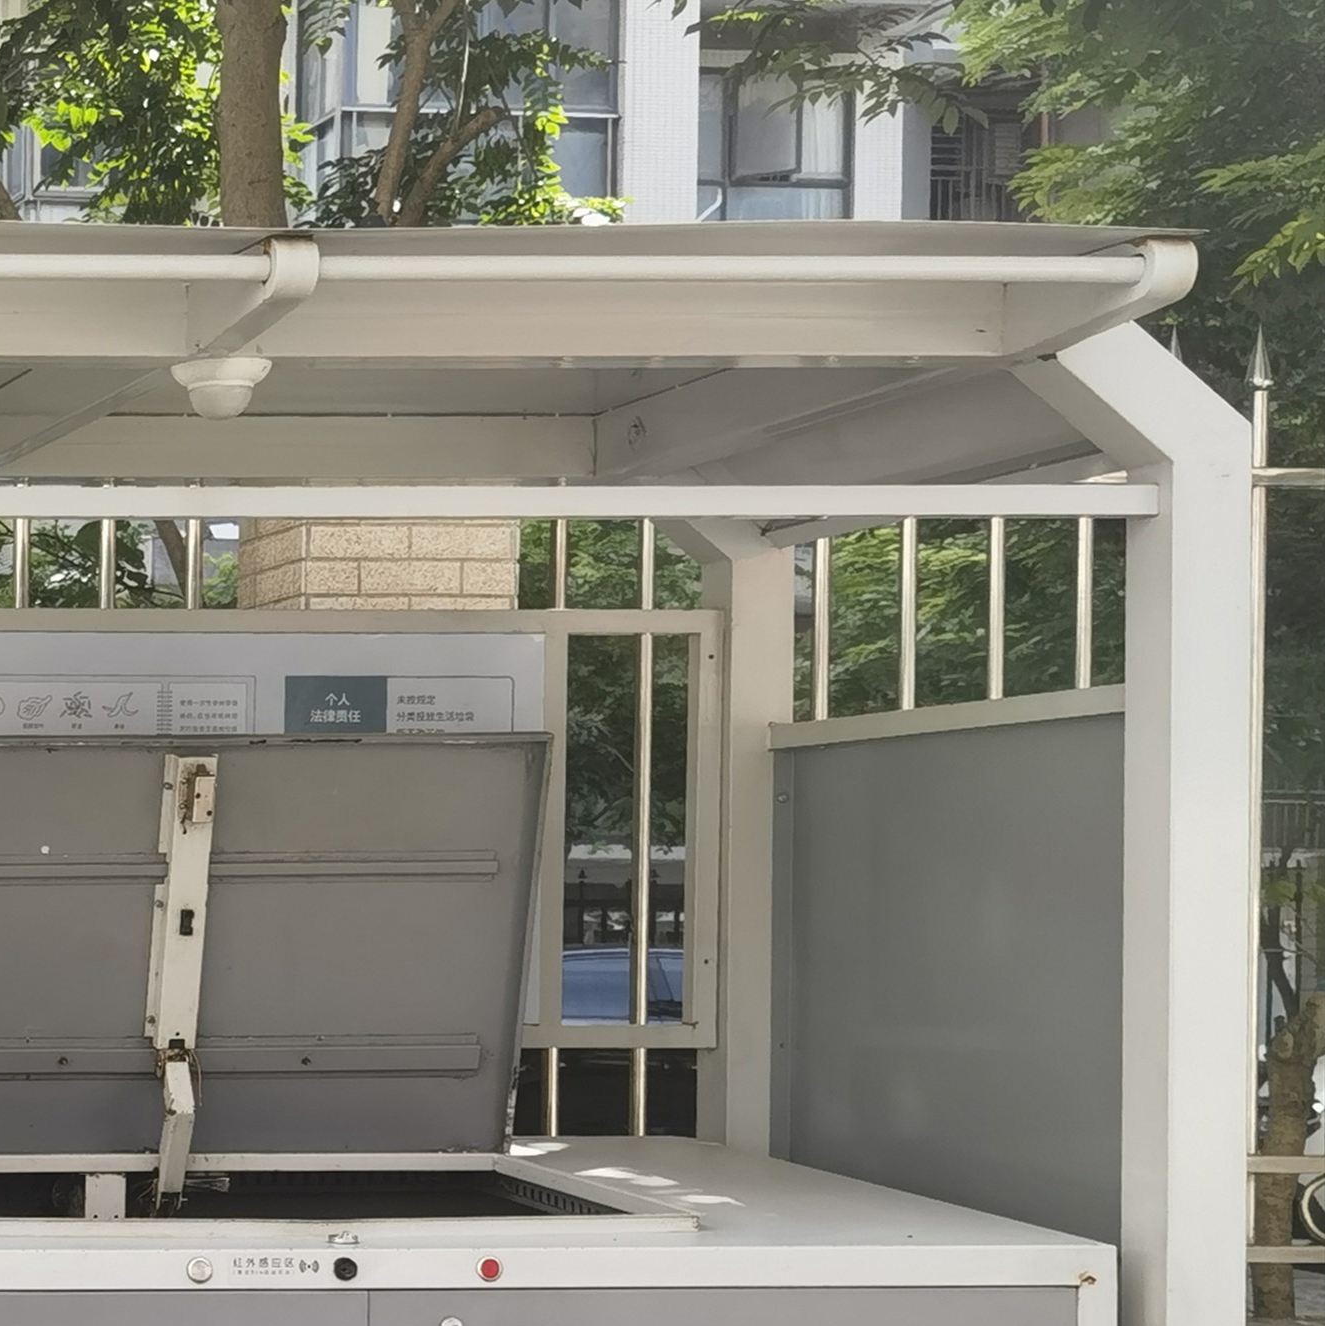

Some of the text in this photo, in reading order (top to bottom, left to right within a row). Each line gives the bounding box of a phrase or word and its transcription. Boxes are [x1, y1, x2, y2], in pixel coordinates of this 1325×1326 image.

[325, 693, 350, 707] 个人
[309, 709, 362, 723] 法律责任
[232, 1256, 295, 1269] 红外感应区
